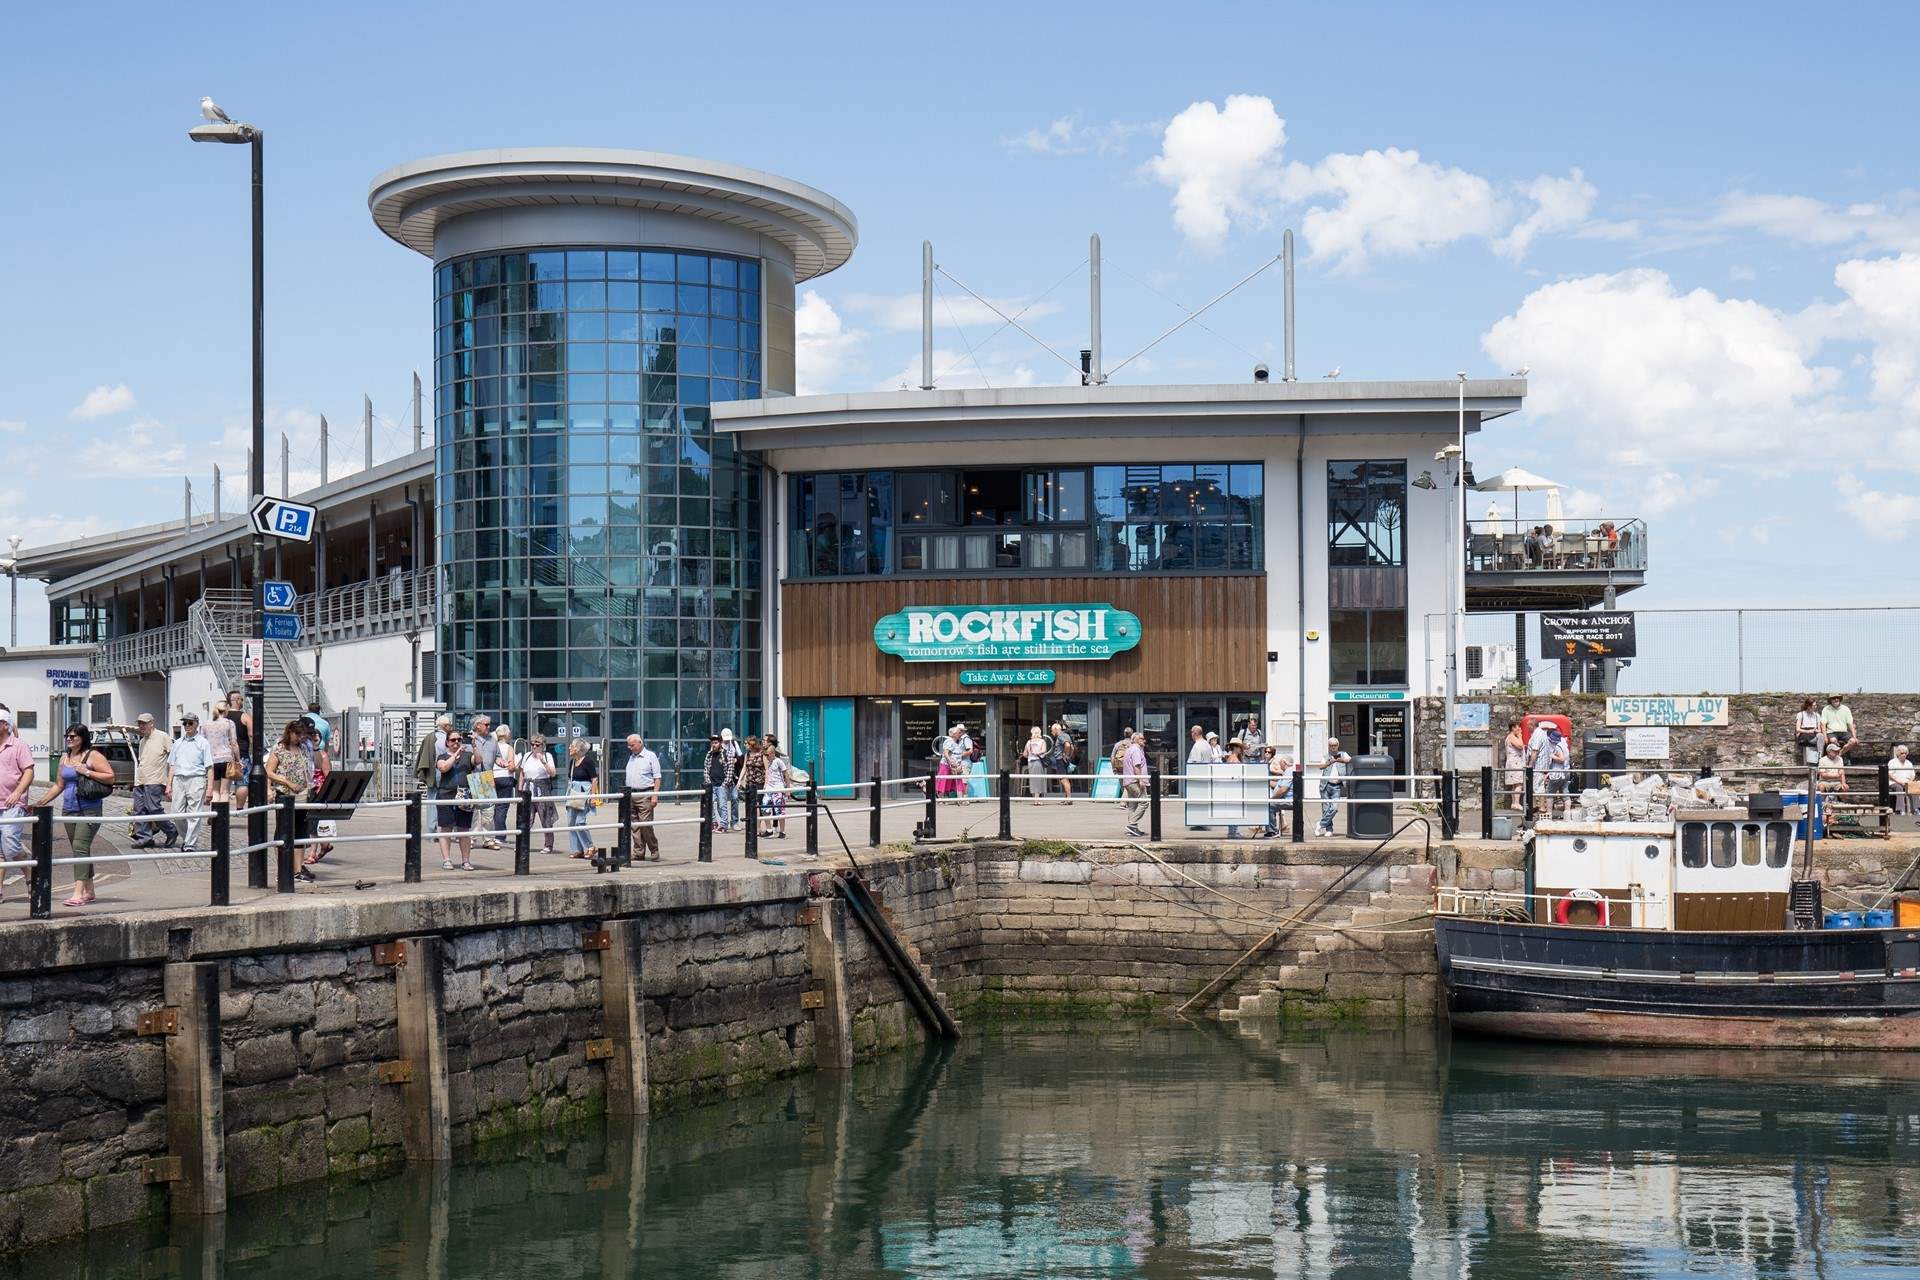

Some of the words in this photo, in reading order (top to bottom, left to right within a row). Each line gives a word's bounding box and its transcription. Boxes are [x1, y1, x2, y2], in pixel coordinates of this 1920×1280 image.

[280, 509, 298, 529] P
[288, 525, 302, 533] 214
[274, 618, 294, 626] Ferries
[908, 609, 1109, 643] ROCKFISH
[1544, 618, 1578, 626] CROWN
[1591, 617, 1631, 625] ANCHOR
[274, 627, 292, 635] Toilets
[908, 645, 974, 656] tomorrow's
[977, 644, 997, 655] fish
[1002, 645, 1020, 657] are
[1024, 643, 1047, 655] still
[1051, 644, 1064, 654] in
[1067, 643, 1086, 654] the
[1090, 645, 1109, 653] sea
[46, 669, 79, 679] BRIXHAM
[967, 672, 988, 682] Take
[990, 672, 1014, 683] Away
[1017, 672, 1025, 681] &
[53, 679, 72, 688] PORT
[1611, 699, 1675, 713] WESTERN
[1687, 699, 1723, 713] LADY
[1645, 712, 1688, 725] FERRY
